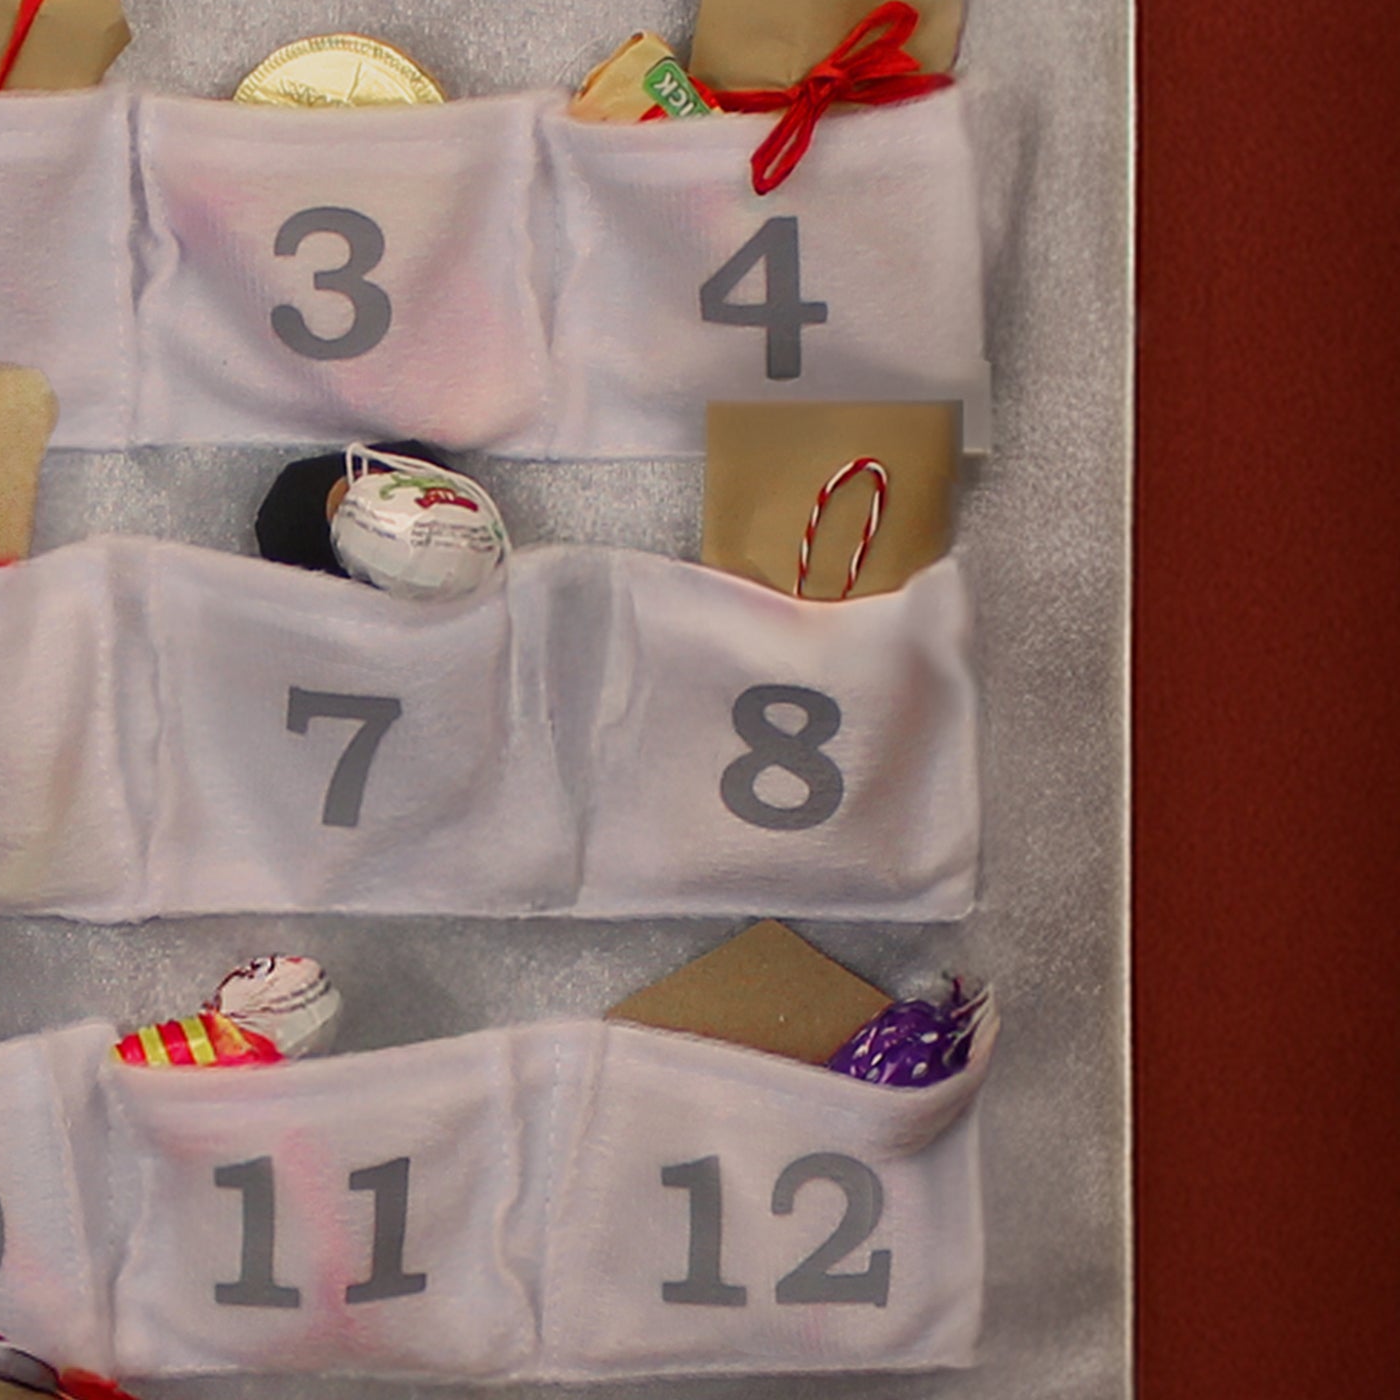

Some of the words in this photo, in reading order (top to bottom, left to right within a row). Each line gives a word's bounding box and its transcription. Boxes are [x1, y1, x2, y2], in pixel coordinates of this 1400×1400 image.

[653, 72, 698, 116] ICK
[271, 207, 391, 360] 3
[699, 216, 828, 382] 4
[286, 685, 403, 828] 7
[720, 684, 844, 831] 8
[214, 1156, 428, 1308] 11
[661, 1152, 891, 1307] 12
